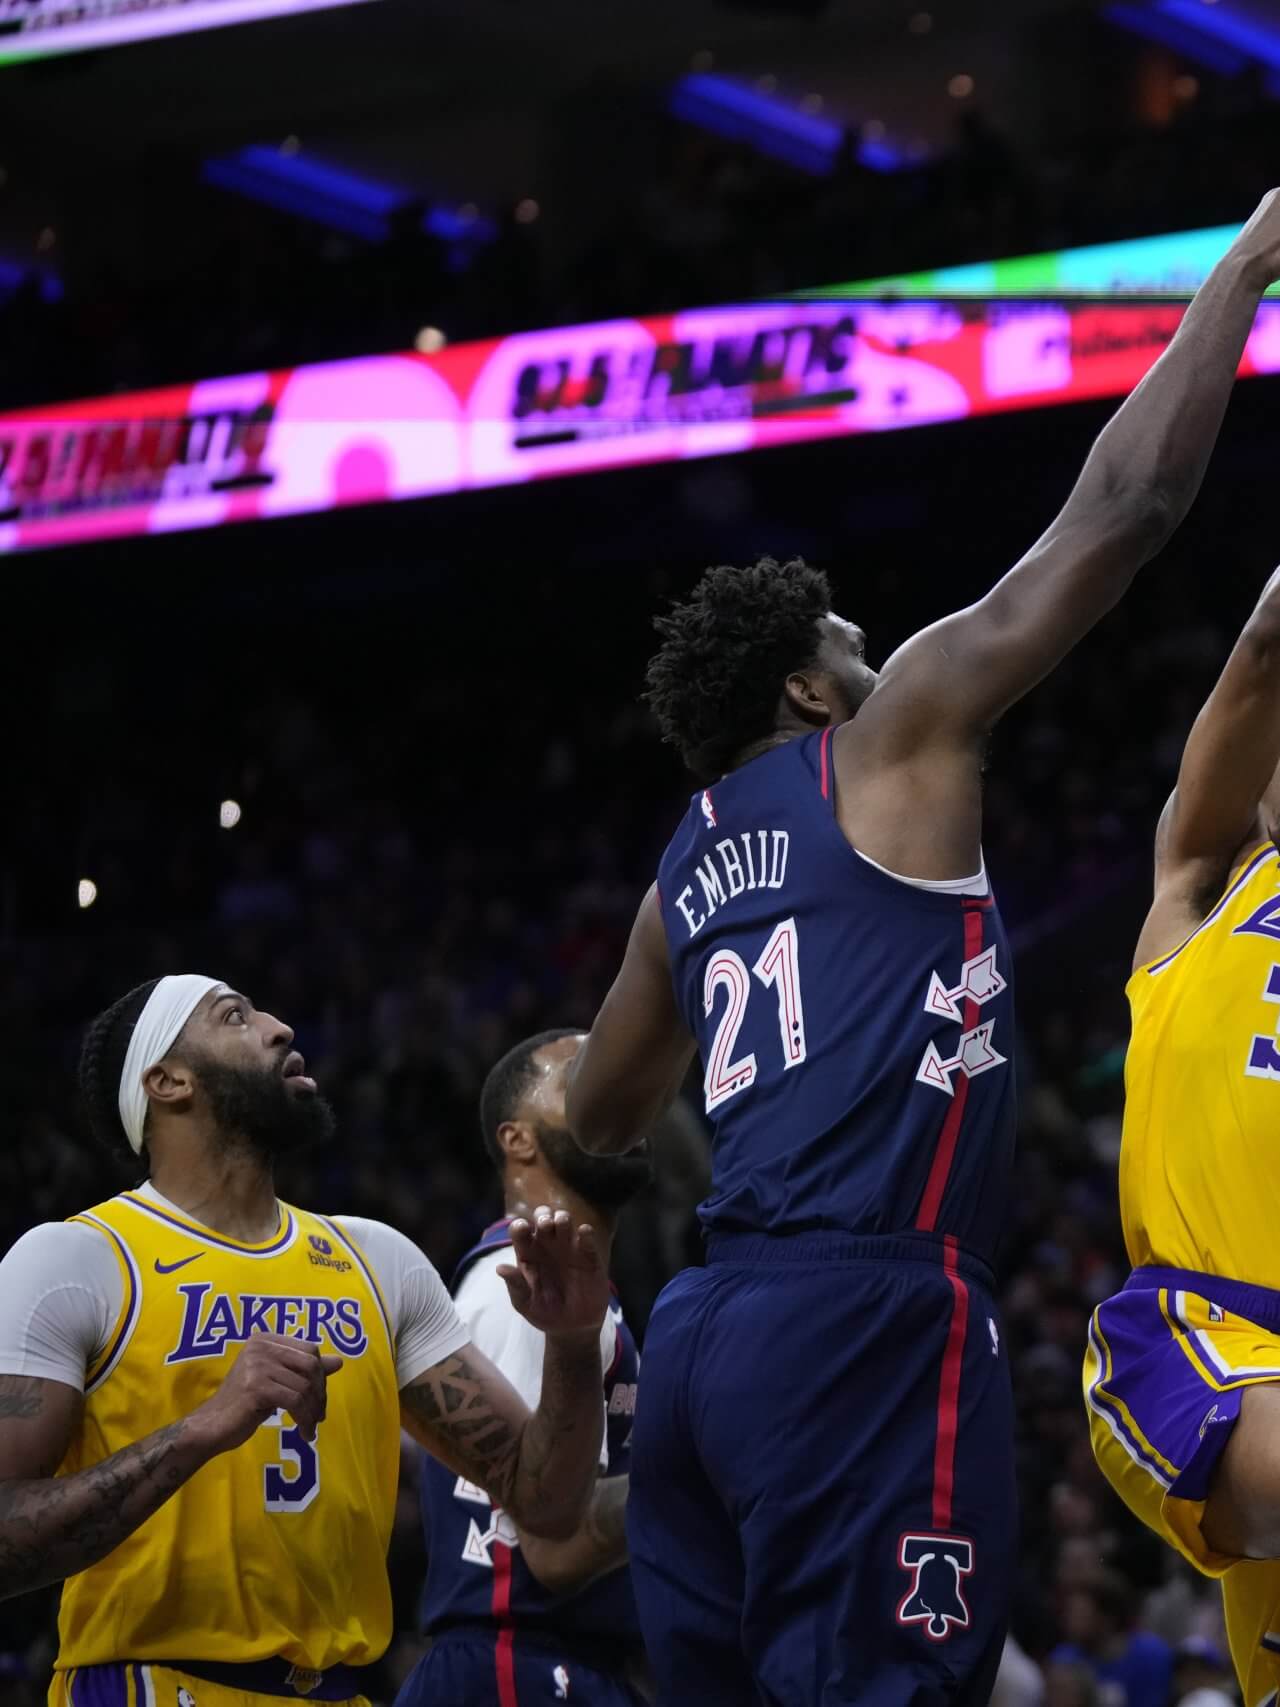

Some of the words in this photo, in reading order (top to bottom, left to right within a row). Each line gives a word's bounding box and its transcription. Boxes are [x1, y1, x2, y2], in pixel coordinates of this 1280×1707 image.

[675, 830, 789, 938] EMBIID
[702, 916, 807, 1115] 21
[308, 1252, 353, 1273] bibigo
[164, 1281, 369, 1366] LAKERS
[264, 1407, 321, 1513] 3
